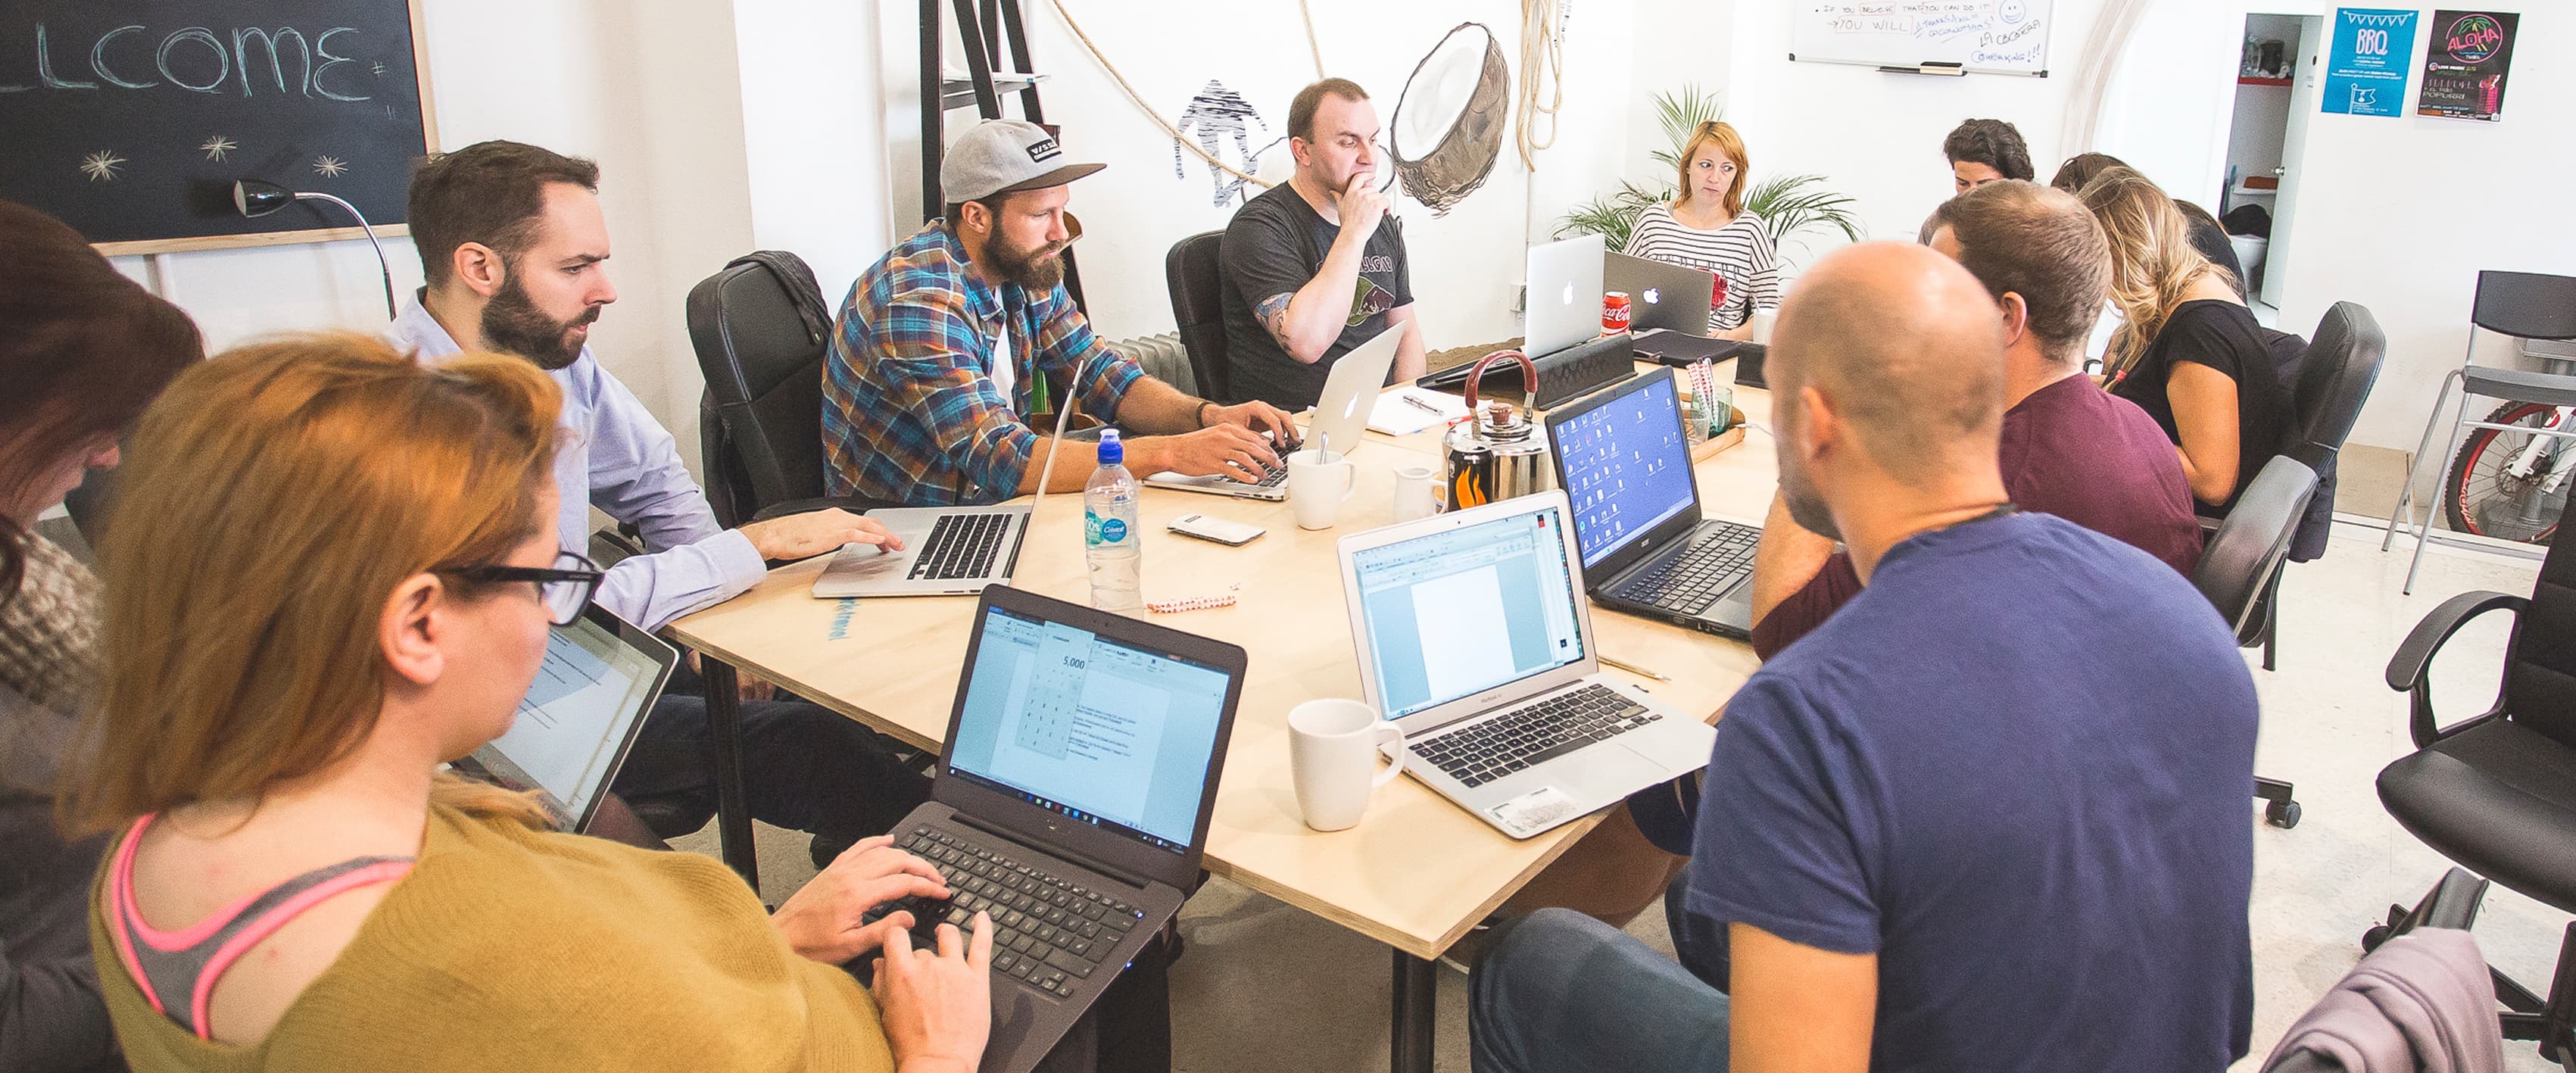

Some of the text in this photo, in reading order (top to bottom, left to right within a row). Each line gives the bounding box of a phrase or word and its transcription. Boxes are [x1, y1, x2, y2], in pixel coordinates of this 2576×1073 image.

[1839, 19, 1908, 32] YOU WILL
[2356, 29, 2388, 55] BBQ
[2447, 28, 2500, 51] ALOHA
[0, 22, 371, 102] LCOME
[1031, 142, 1056, 154] VISS
